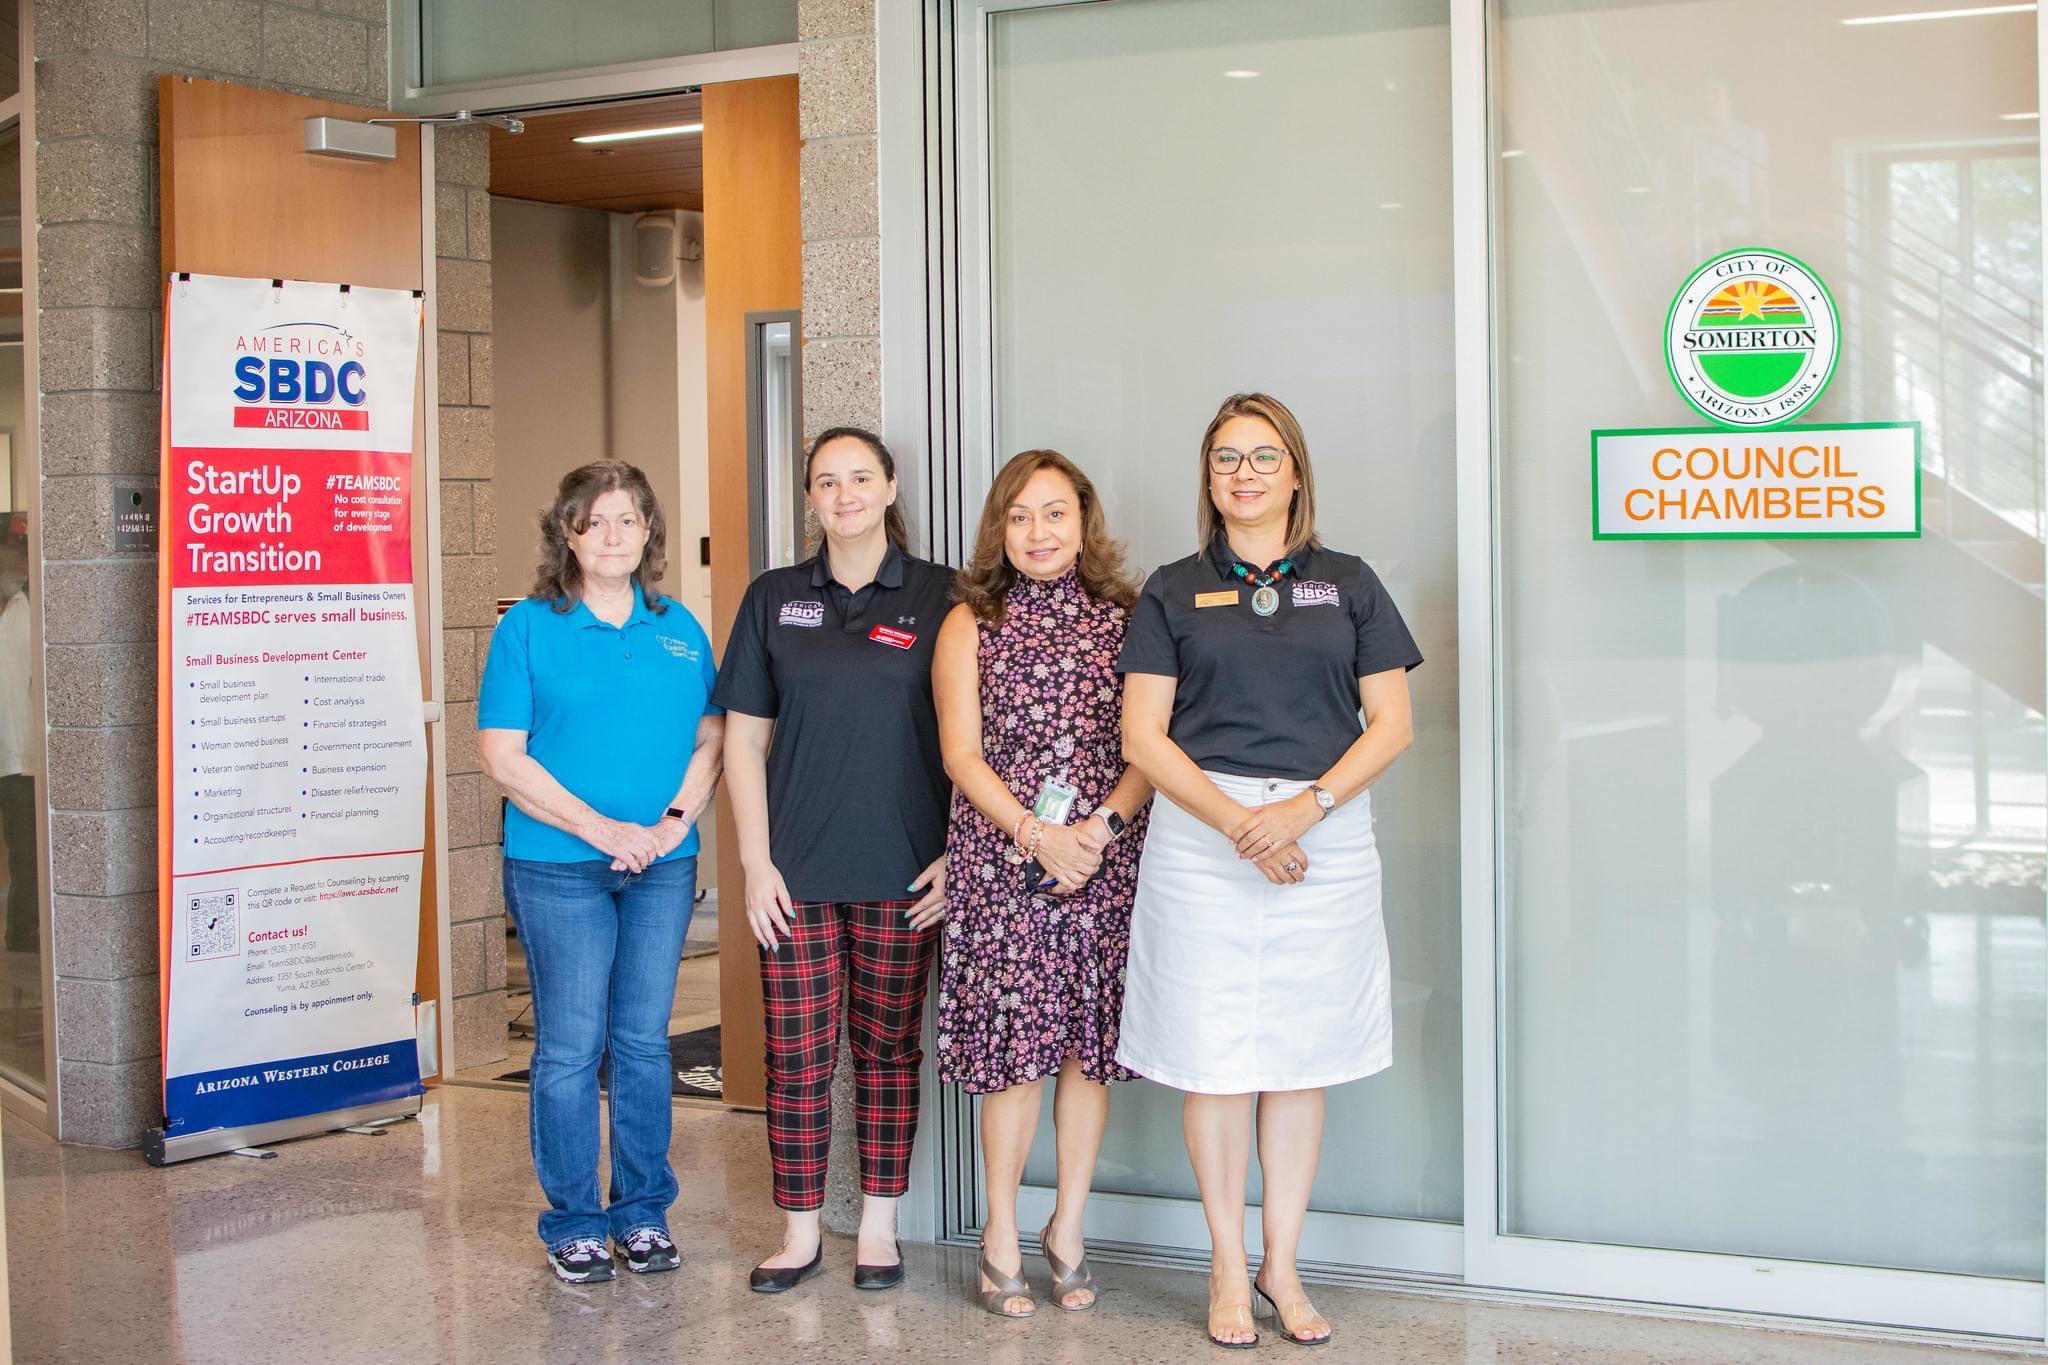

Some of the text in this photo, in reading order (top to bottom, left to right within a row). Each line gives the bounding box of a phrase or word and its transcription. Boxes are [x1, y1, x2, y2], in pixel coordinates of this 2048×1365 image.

[1716, 260, 1791, 278] CITY OF
[1683, 330, 1817, 349] SOMERTON
[233, 356, 367, 407] SBDC
[1695, 383, 1812, 418] ARIZONA 1898
[264, 410, 343, 429] ARIZONA
[1651, 446, 1858, 481] COUNCIL
[187, 460, 300, 503] StartUp
[326, 475, 400, 491] #TEAMSBDC
[335, 494, 402, 504] No cost consultation
[1624, 485, 1886, 521] CHAMBERS
[188, 503, 292, 533] Growth
[334, 508, 390, 520] for every stage
[334, 522, 392, 534] of development
[187, 542, 321, 572] Transition
[187, 591, 406, 605] Services for Entrepreneurs & Small Business Owners
[186, 608, 407, 626] #TEAMSBDC serves small business.
[186, 650, 367, 667] Small Business Development Center
[200, 679, 256, 690] Small business
[314, 673, 385, 683] International trade
[200, 691, 269, 705] development plan
[313, 696, 365, 707] Cost analysis
[200, 714, 286, 727] Small business startups
[313, 719, 387, 730] Financial strategies
[201, 736, 289, 751] Woman owned business
[312, 740, 412, 752] Government procurement
[202, 759, 289, 775] Veteran owned business
[312, 763, 386, 775] Business expansion
[204, 788, 242, 799] Marketing
[311, 786, 400, 797] Disaster relief/recovery
[203, 805, 292, 823] Organizational structures
[311, 808, 379, 820] Financial planning
[203, 827, 297, 847] Accounting/recordkeeping
[247, 887, 281, 899] Complete
[291, 883, 316, 894] Request
[327, 877, 365, 887] Counseling
[367, 876, 376, 885] by
[378, 873, 409, 883] scanning
[248, 902, 259, 910] this
[262, 899, 273, 907] QR
[275, 897, 292, 906] code
[248, 925, 308, 943] Contact us!
[247, 949, 269, 957] Phone:
[246, 975, 275, 985] Address:
[295, 970, 314, 979] South
[315, 966, 344, 975] Redondo
[346, 963, 366, 972] Center
[299, 981, 309, 989] AZ
[244, 1005, 288, 1017] Counseling
[291, 1002, 297, 1010] is
[299, 1001, 309, 1011] by
[357, 991, 373, 1001] only.
